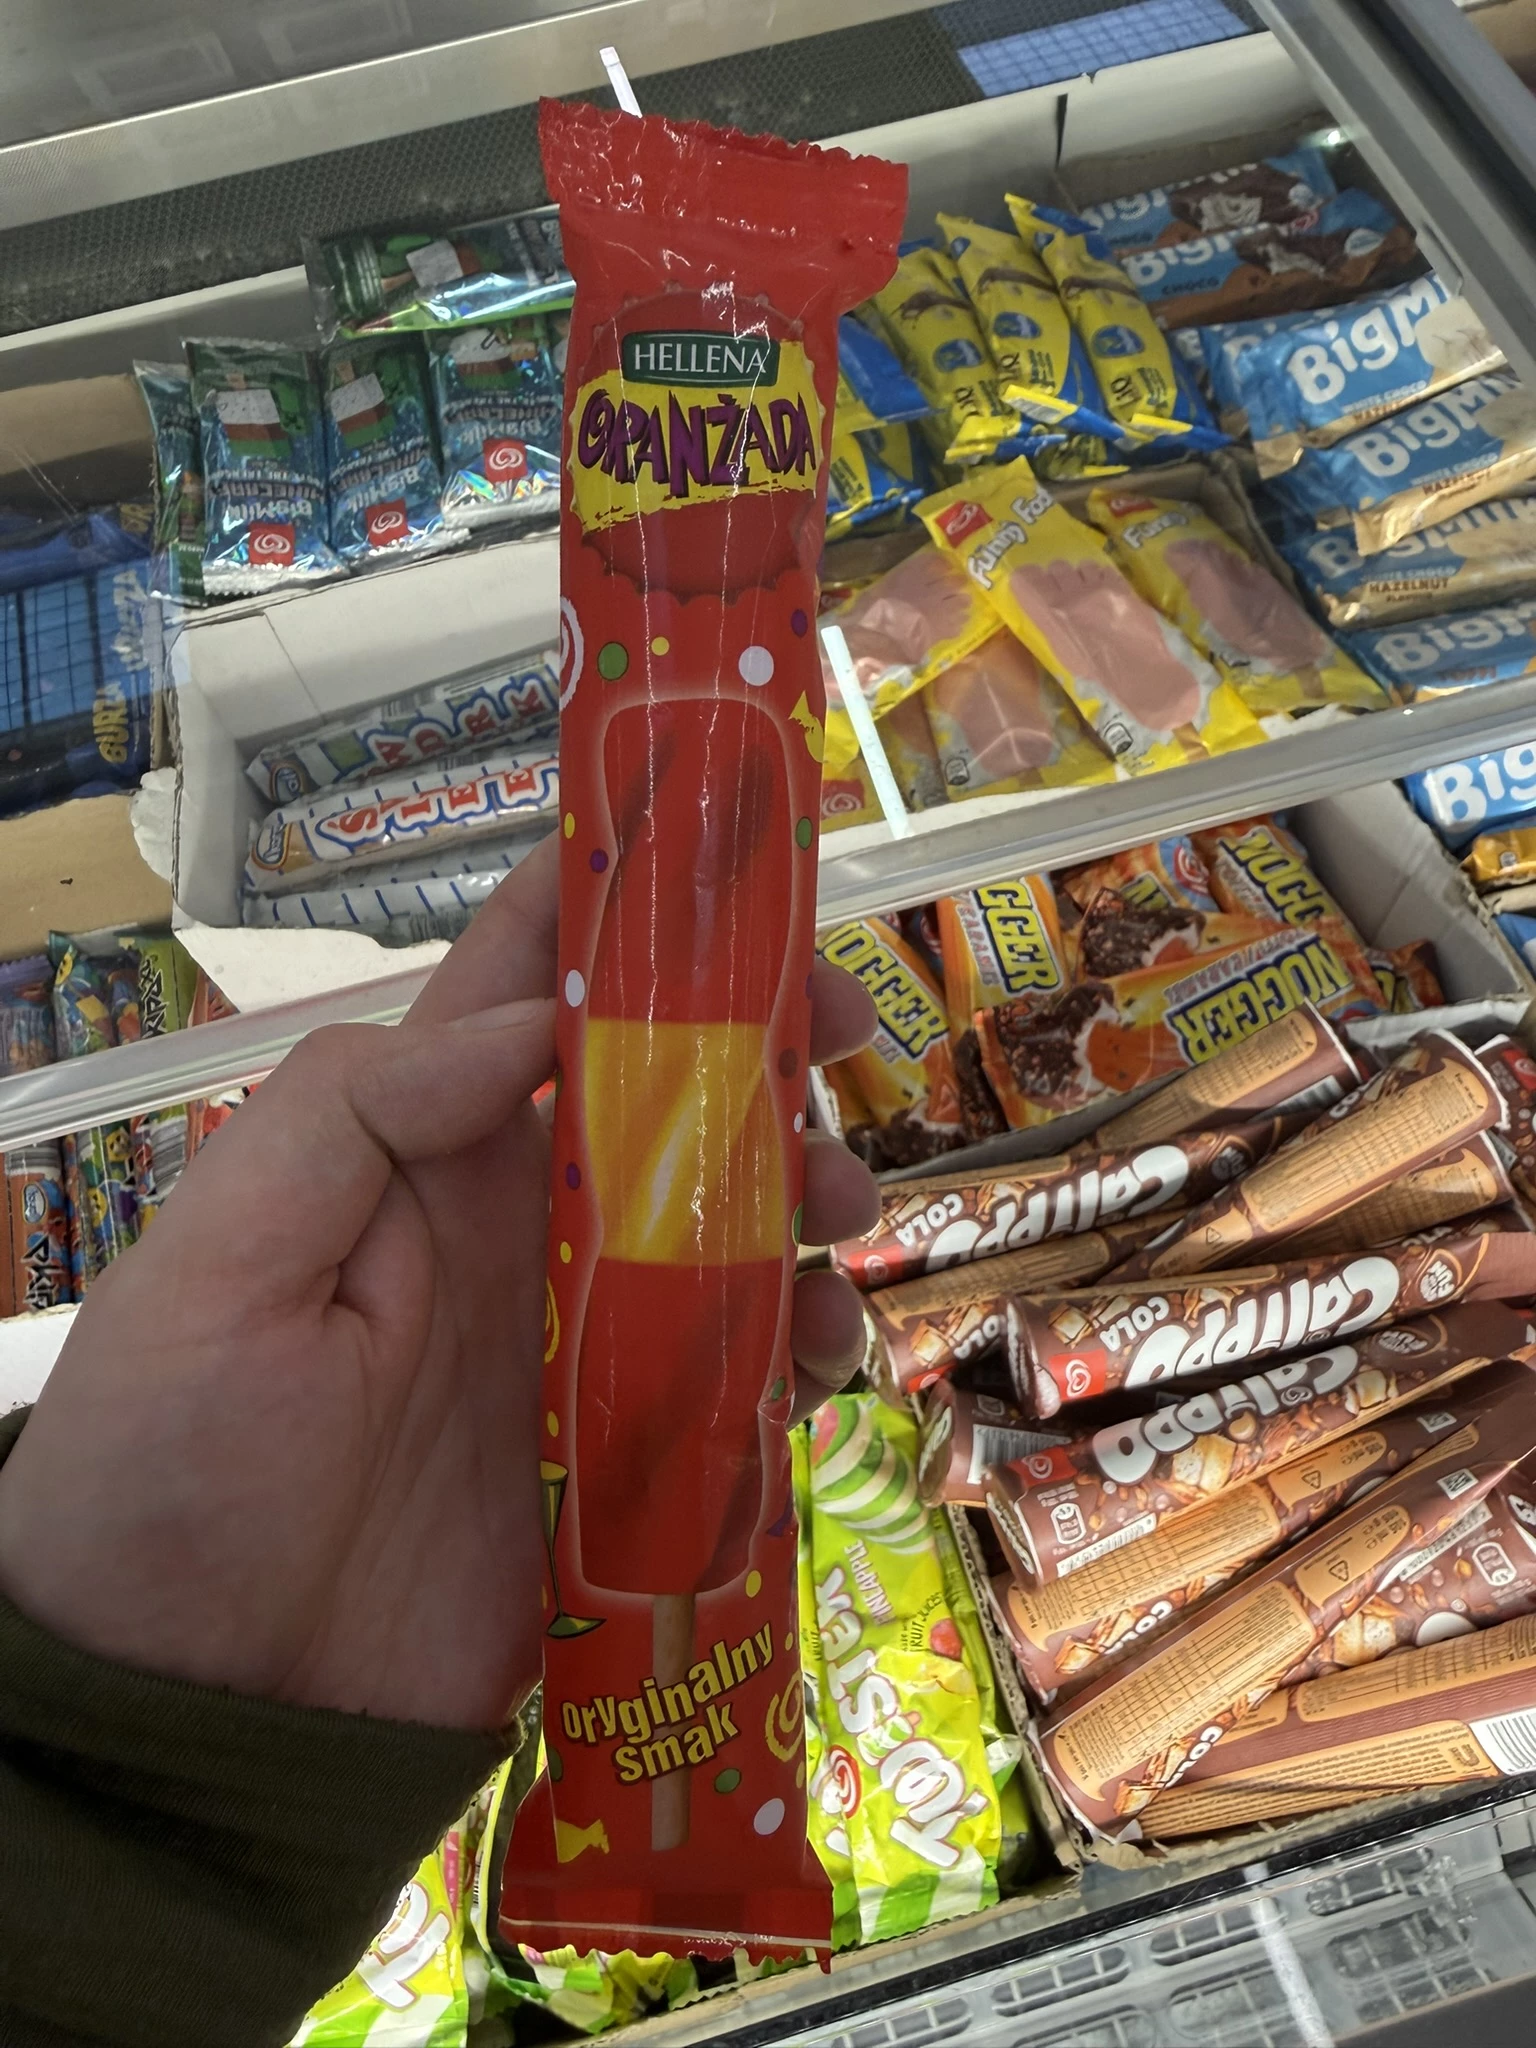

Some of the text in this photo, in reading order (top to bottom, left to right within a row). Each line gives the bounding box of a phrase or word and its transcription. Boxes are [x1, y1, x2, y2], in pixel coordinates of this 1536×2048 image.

[634, 342, 767, 374] HELLENA
[577, 388, 817, 498] ORANŻADA
[967, 519, 1028, 590] Funny
[1369, 578, 1450, 594] HAZELNUT
[821, 920, 951, 1062] OGGER
[1168, 934, 1358, 1067] NOGGER
[895, 1193, 964, 1248] COLA
[924, 1143, 1190, 1275] Calippo
[952, 1314, 1008, 1361] OLA
[1099, 1296, 1171, 1353] COLA
[1123, 1256, 1400, 1391] Calippo
[1092, 1343, 1360, 1486] Calippo
[612, 1702, 741, 1786] smak
